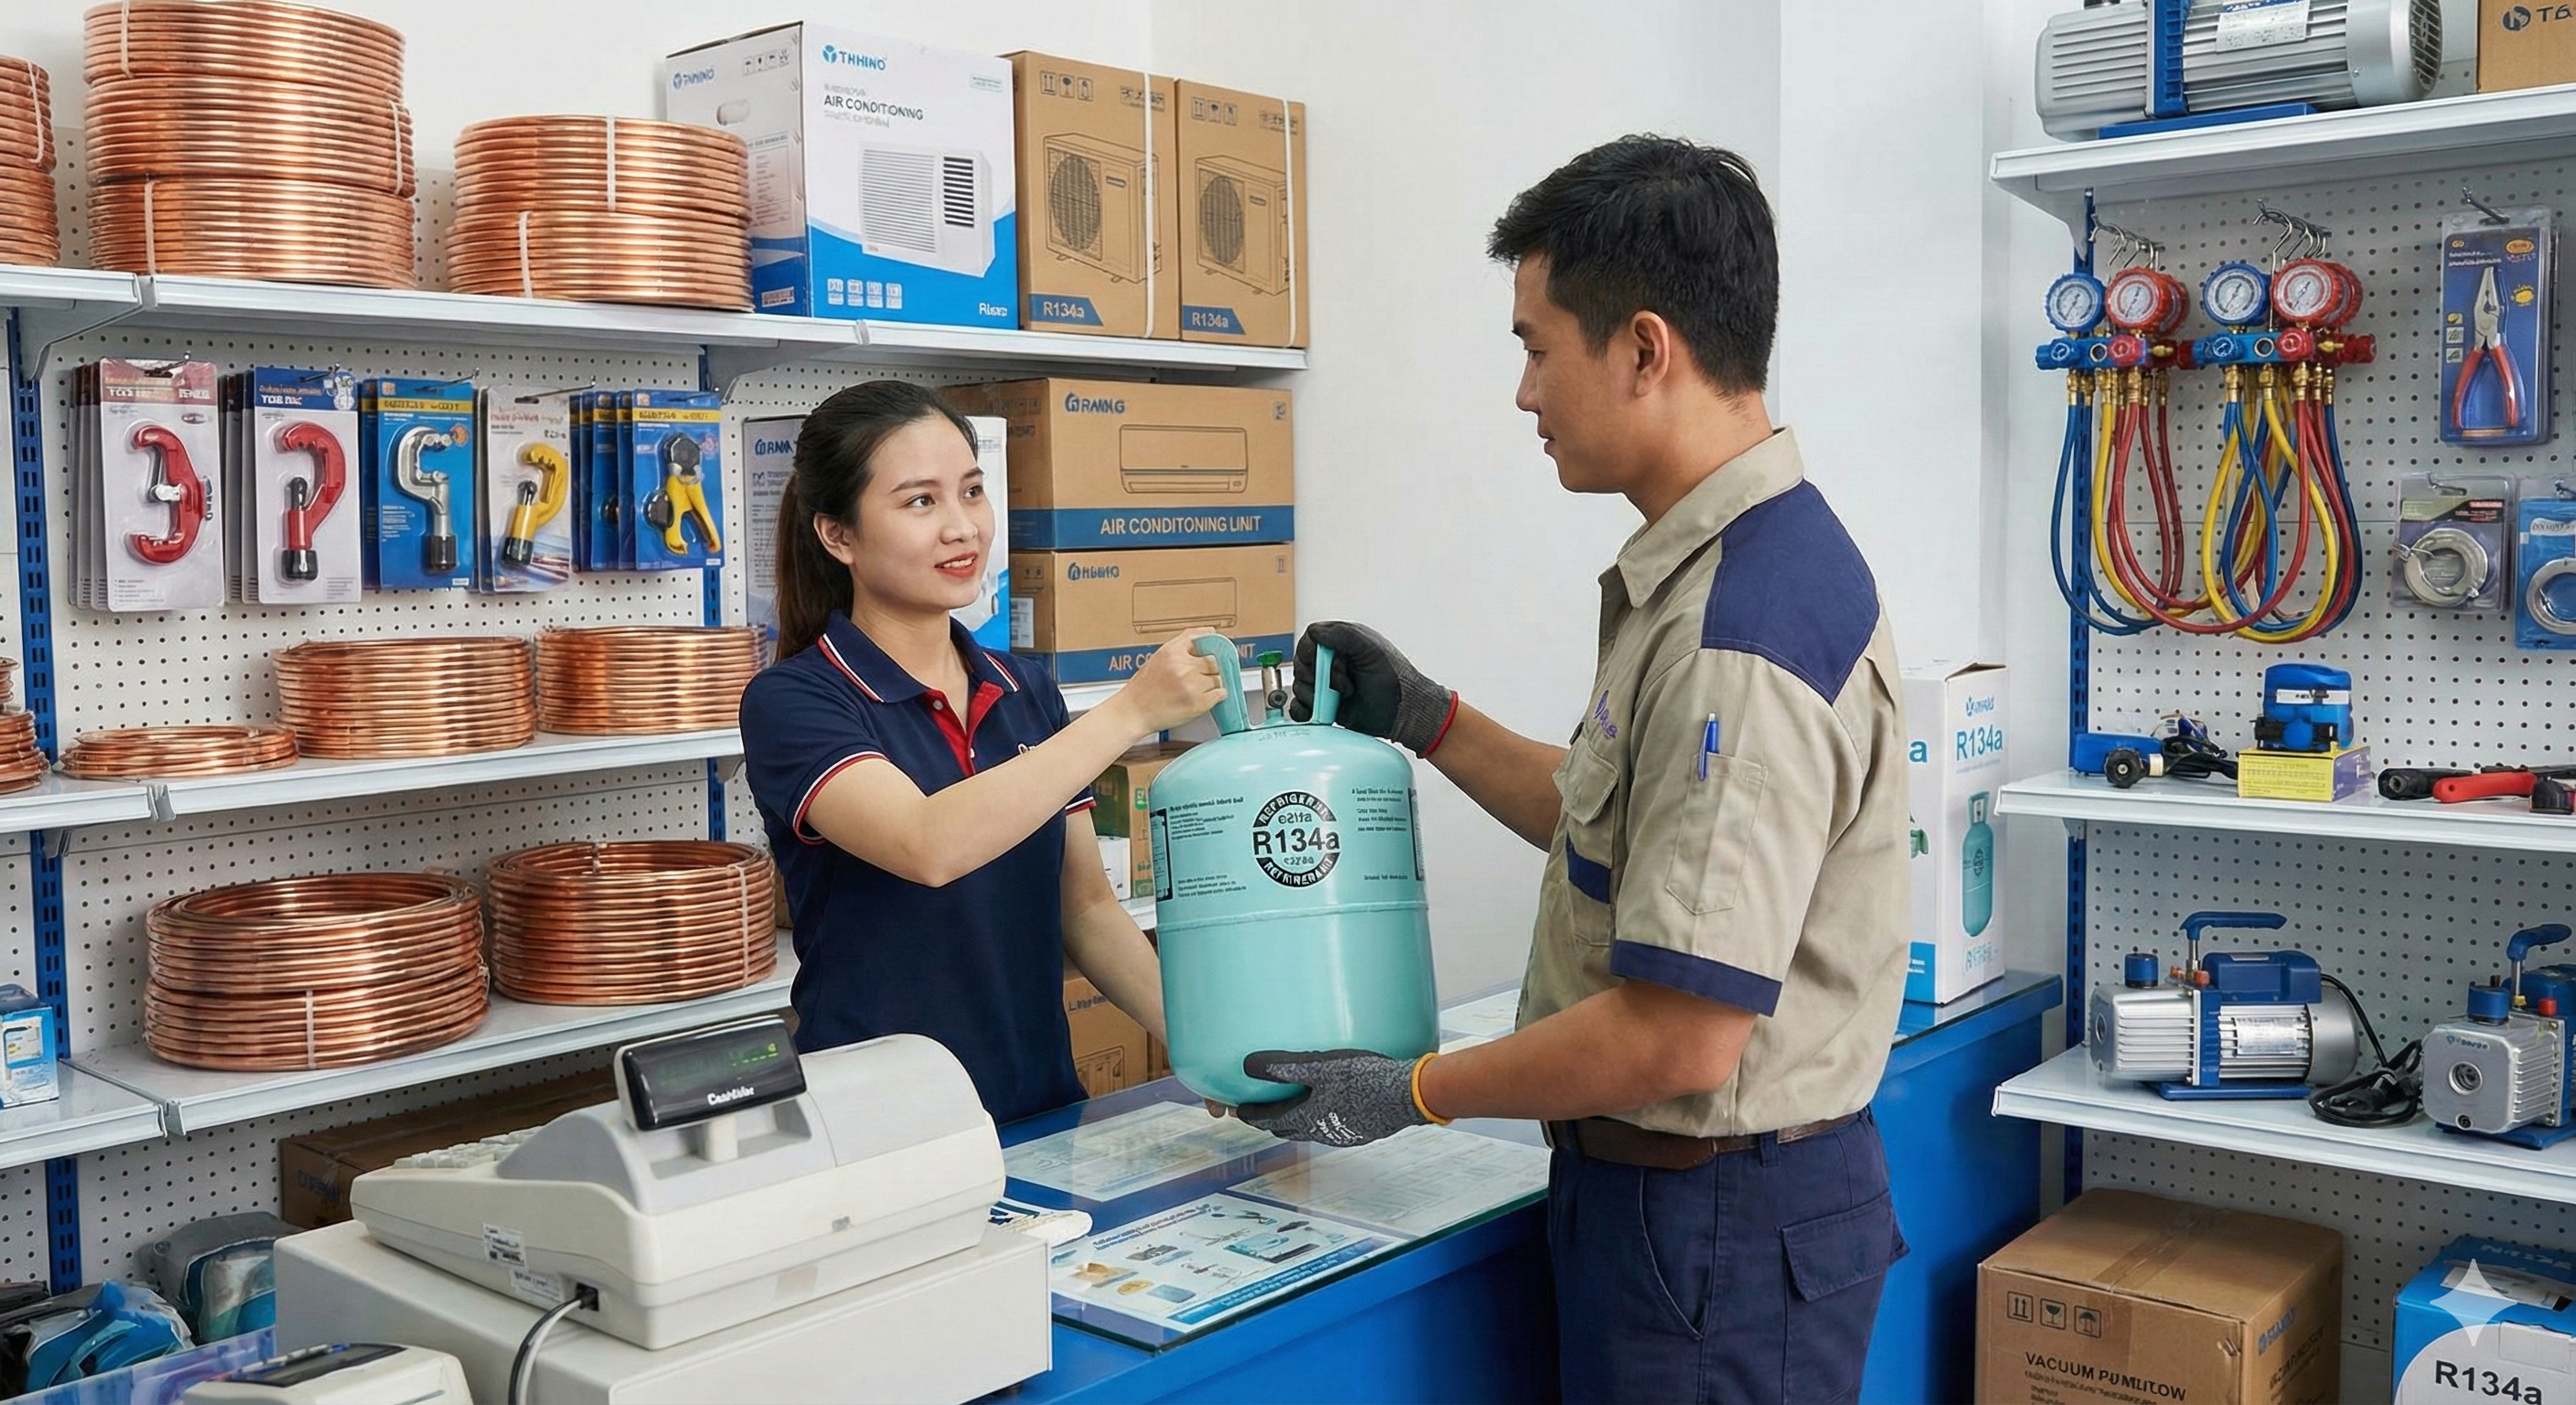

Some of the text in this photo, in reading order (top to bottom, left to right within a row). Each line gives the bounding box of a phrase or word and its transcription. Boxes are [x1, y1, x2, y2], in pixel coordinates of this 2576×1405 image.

[824, 94, 843, 109] AIR
[1043, 301, 1085, 318] R134a
[1192, 312, 1229, 328] R134a
[1100, 518, 1126, 535] AIR
[1109, 655, 1132, 672] AIR
[1956, 724, 2003, 761] R134a
[1252, 827, 1340, 855] R134a
[2024, 1351, 2095, 1380] VACUUM
[2434, 1359, 2543, 1405] R134a
